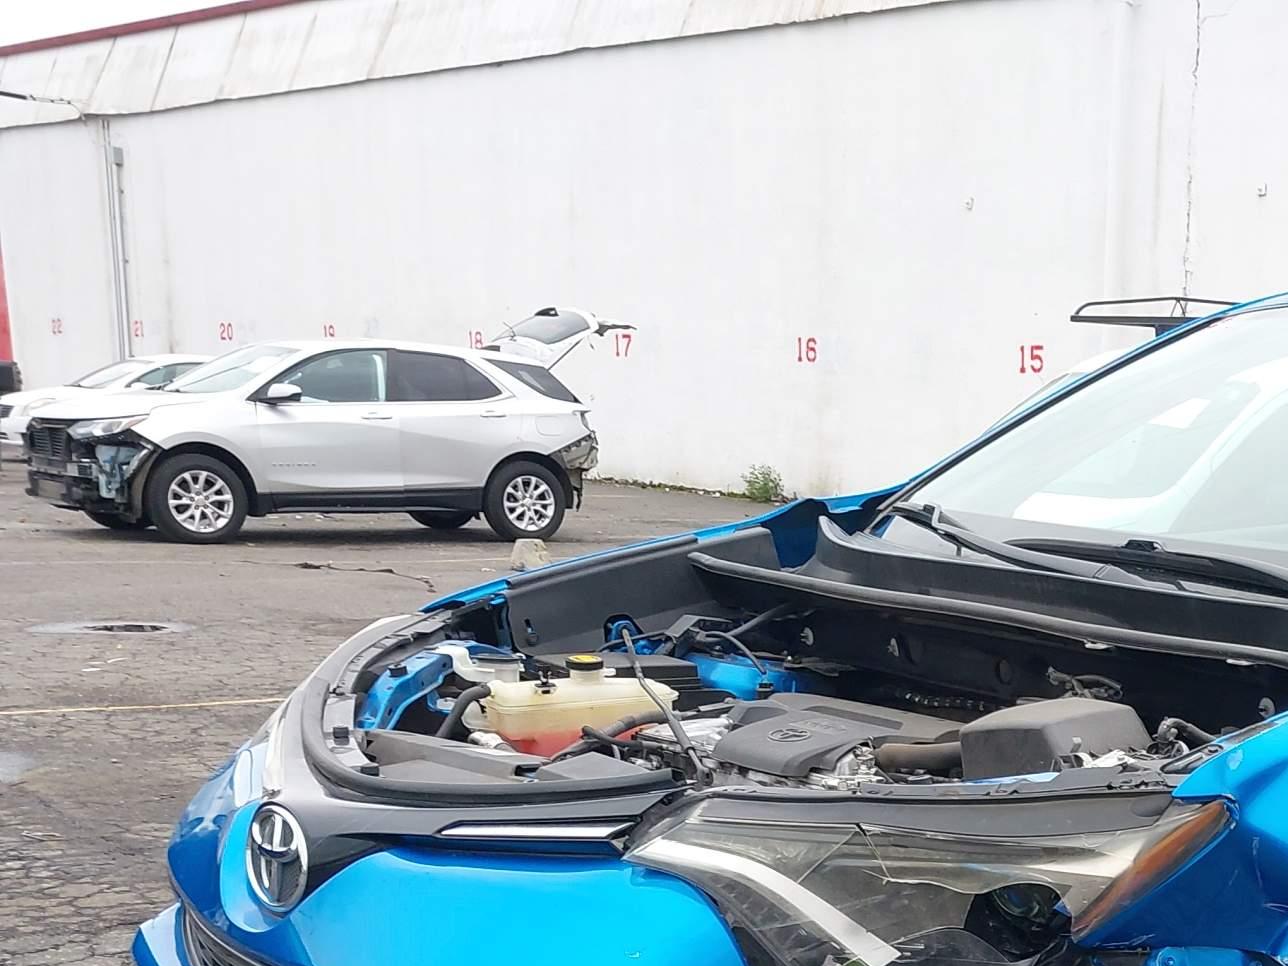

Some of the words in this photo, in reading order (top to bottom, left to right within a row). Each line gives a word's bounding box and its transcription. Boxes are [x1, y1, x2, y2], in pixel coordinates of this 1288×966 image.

[218, 322, 234, 341] 20
[468, 332, 484, 348] 18
[614, 333, 632, 356] 17
[796, 336, 818, 363] 16
[1018, 344, 1045, 375] 15
